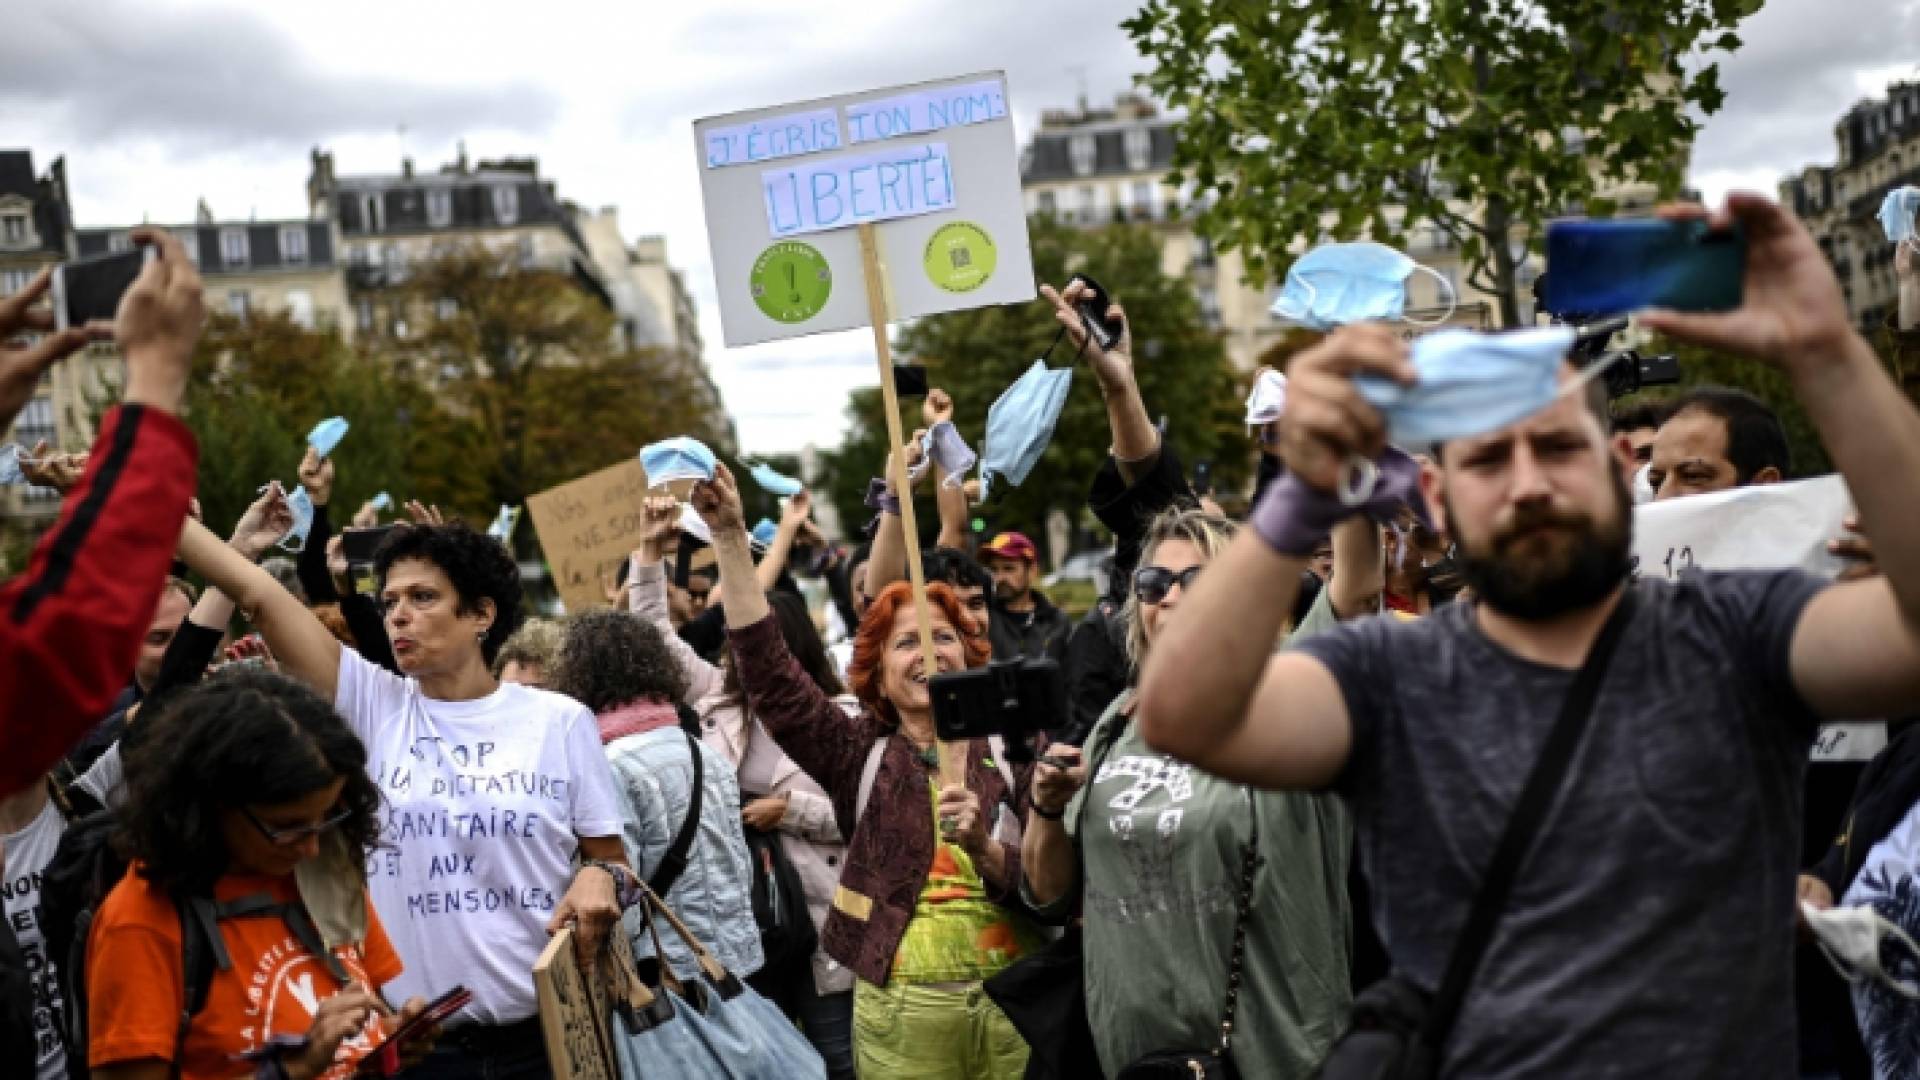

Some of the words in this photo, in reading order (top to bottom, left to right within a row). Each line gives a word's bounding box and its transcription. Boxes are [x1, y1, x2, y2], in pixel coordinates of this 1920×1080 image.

[709, 118, 838, 166] J'ÉCRIS
[848, 107, 911, 139] TON
[410, 736, 495, 767] STOP
[431, 769, 567, 799] DICTATURE
[389, 806, 539, 840] SANITAIRE
[429, 853, 476, 880] AUX
